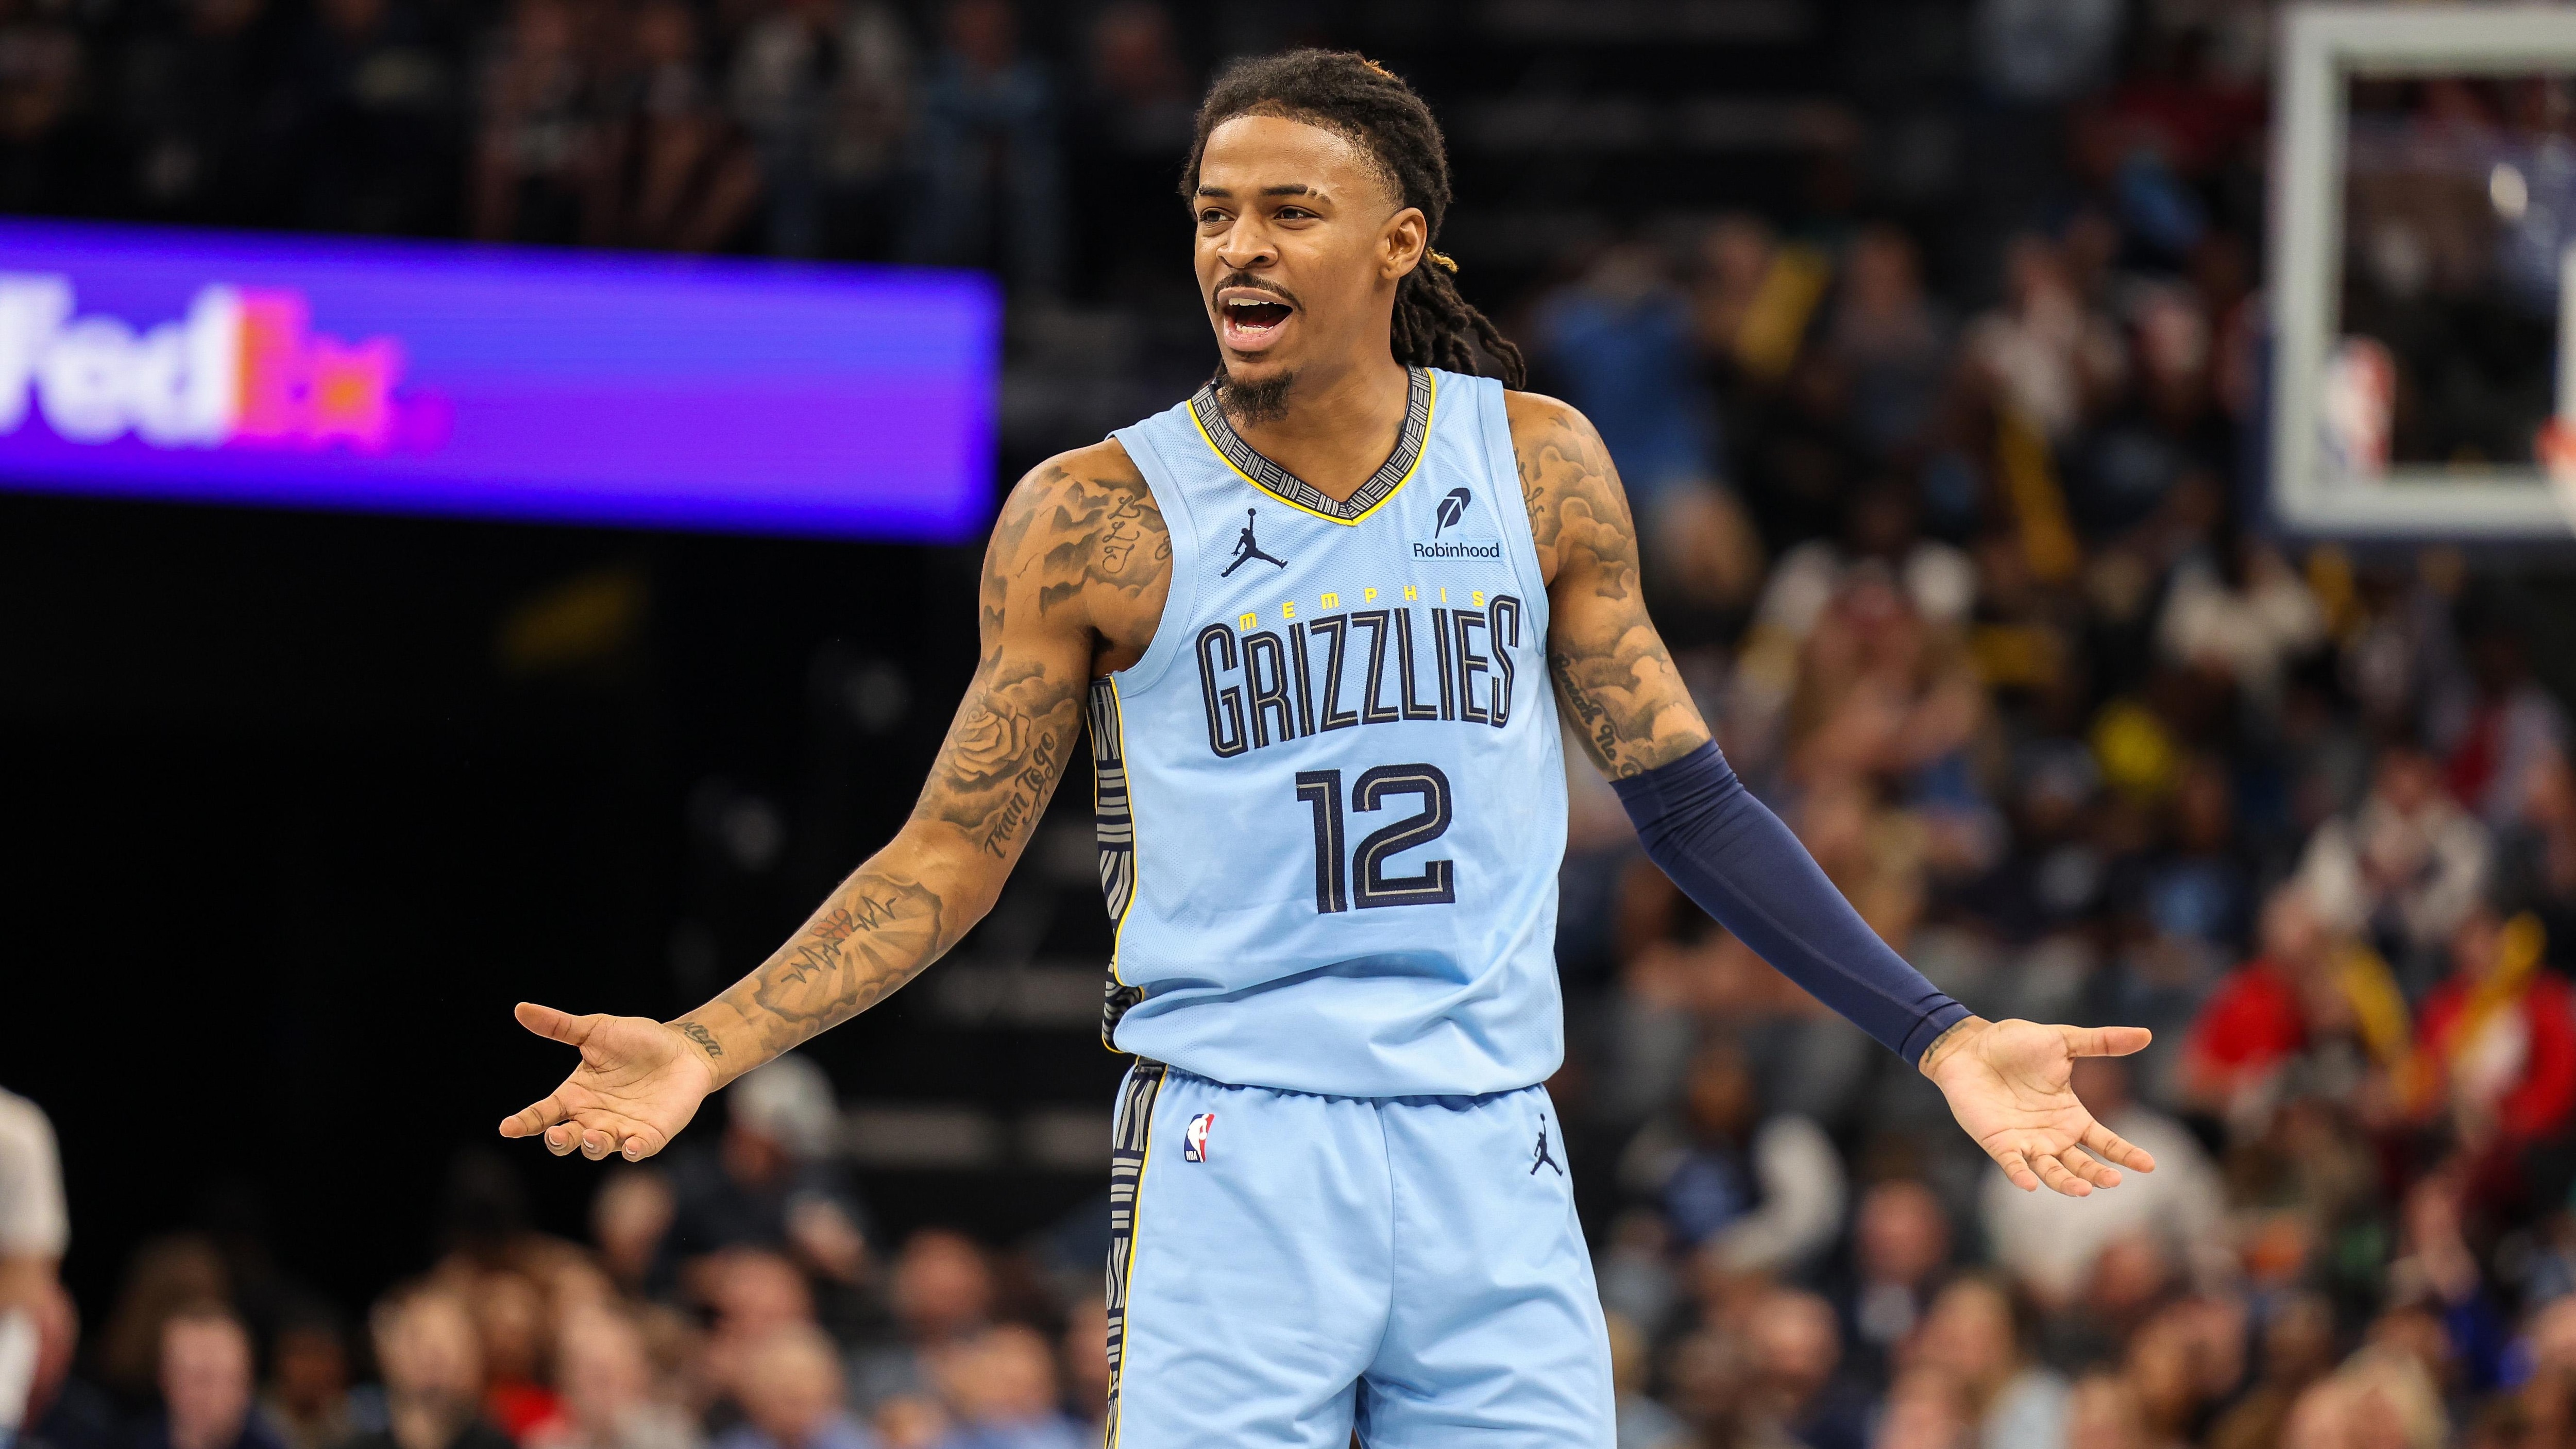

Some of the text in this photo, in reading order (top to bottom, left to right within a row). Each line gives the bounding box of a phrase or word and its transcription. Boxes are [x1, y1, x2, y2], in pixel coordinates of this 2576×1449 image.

[1413, 542, 1500, 558] Robinhood
[1239, 585, 1485, 632] MEMPHIS
[1195, 594, 1521, 758] GRIZZLIES
[1295, 763, 1456, 914] 12
[1185, 1150, 1198, 1161] NBA
